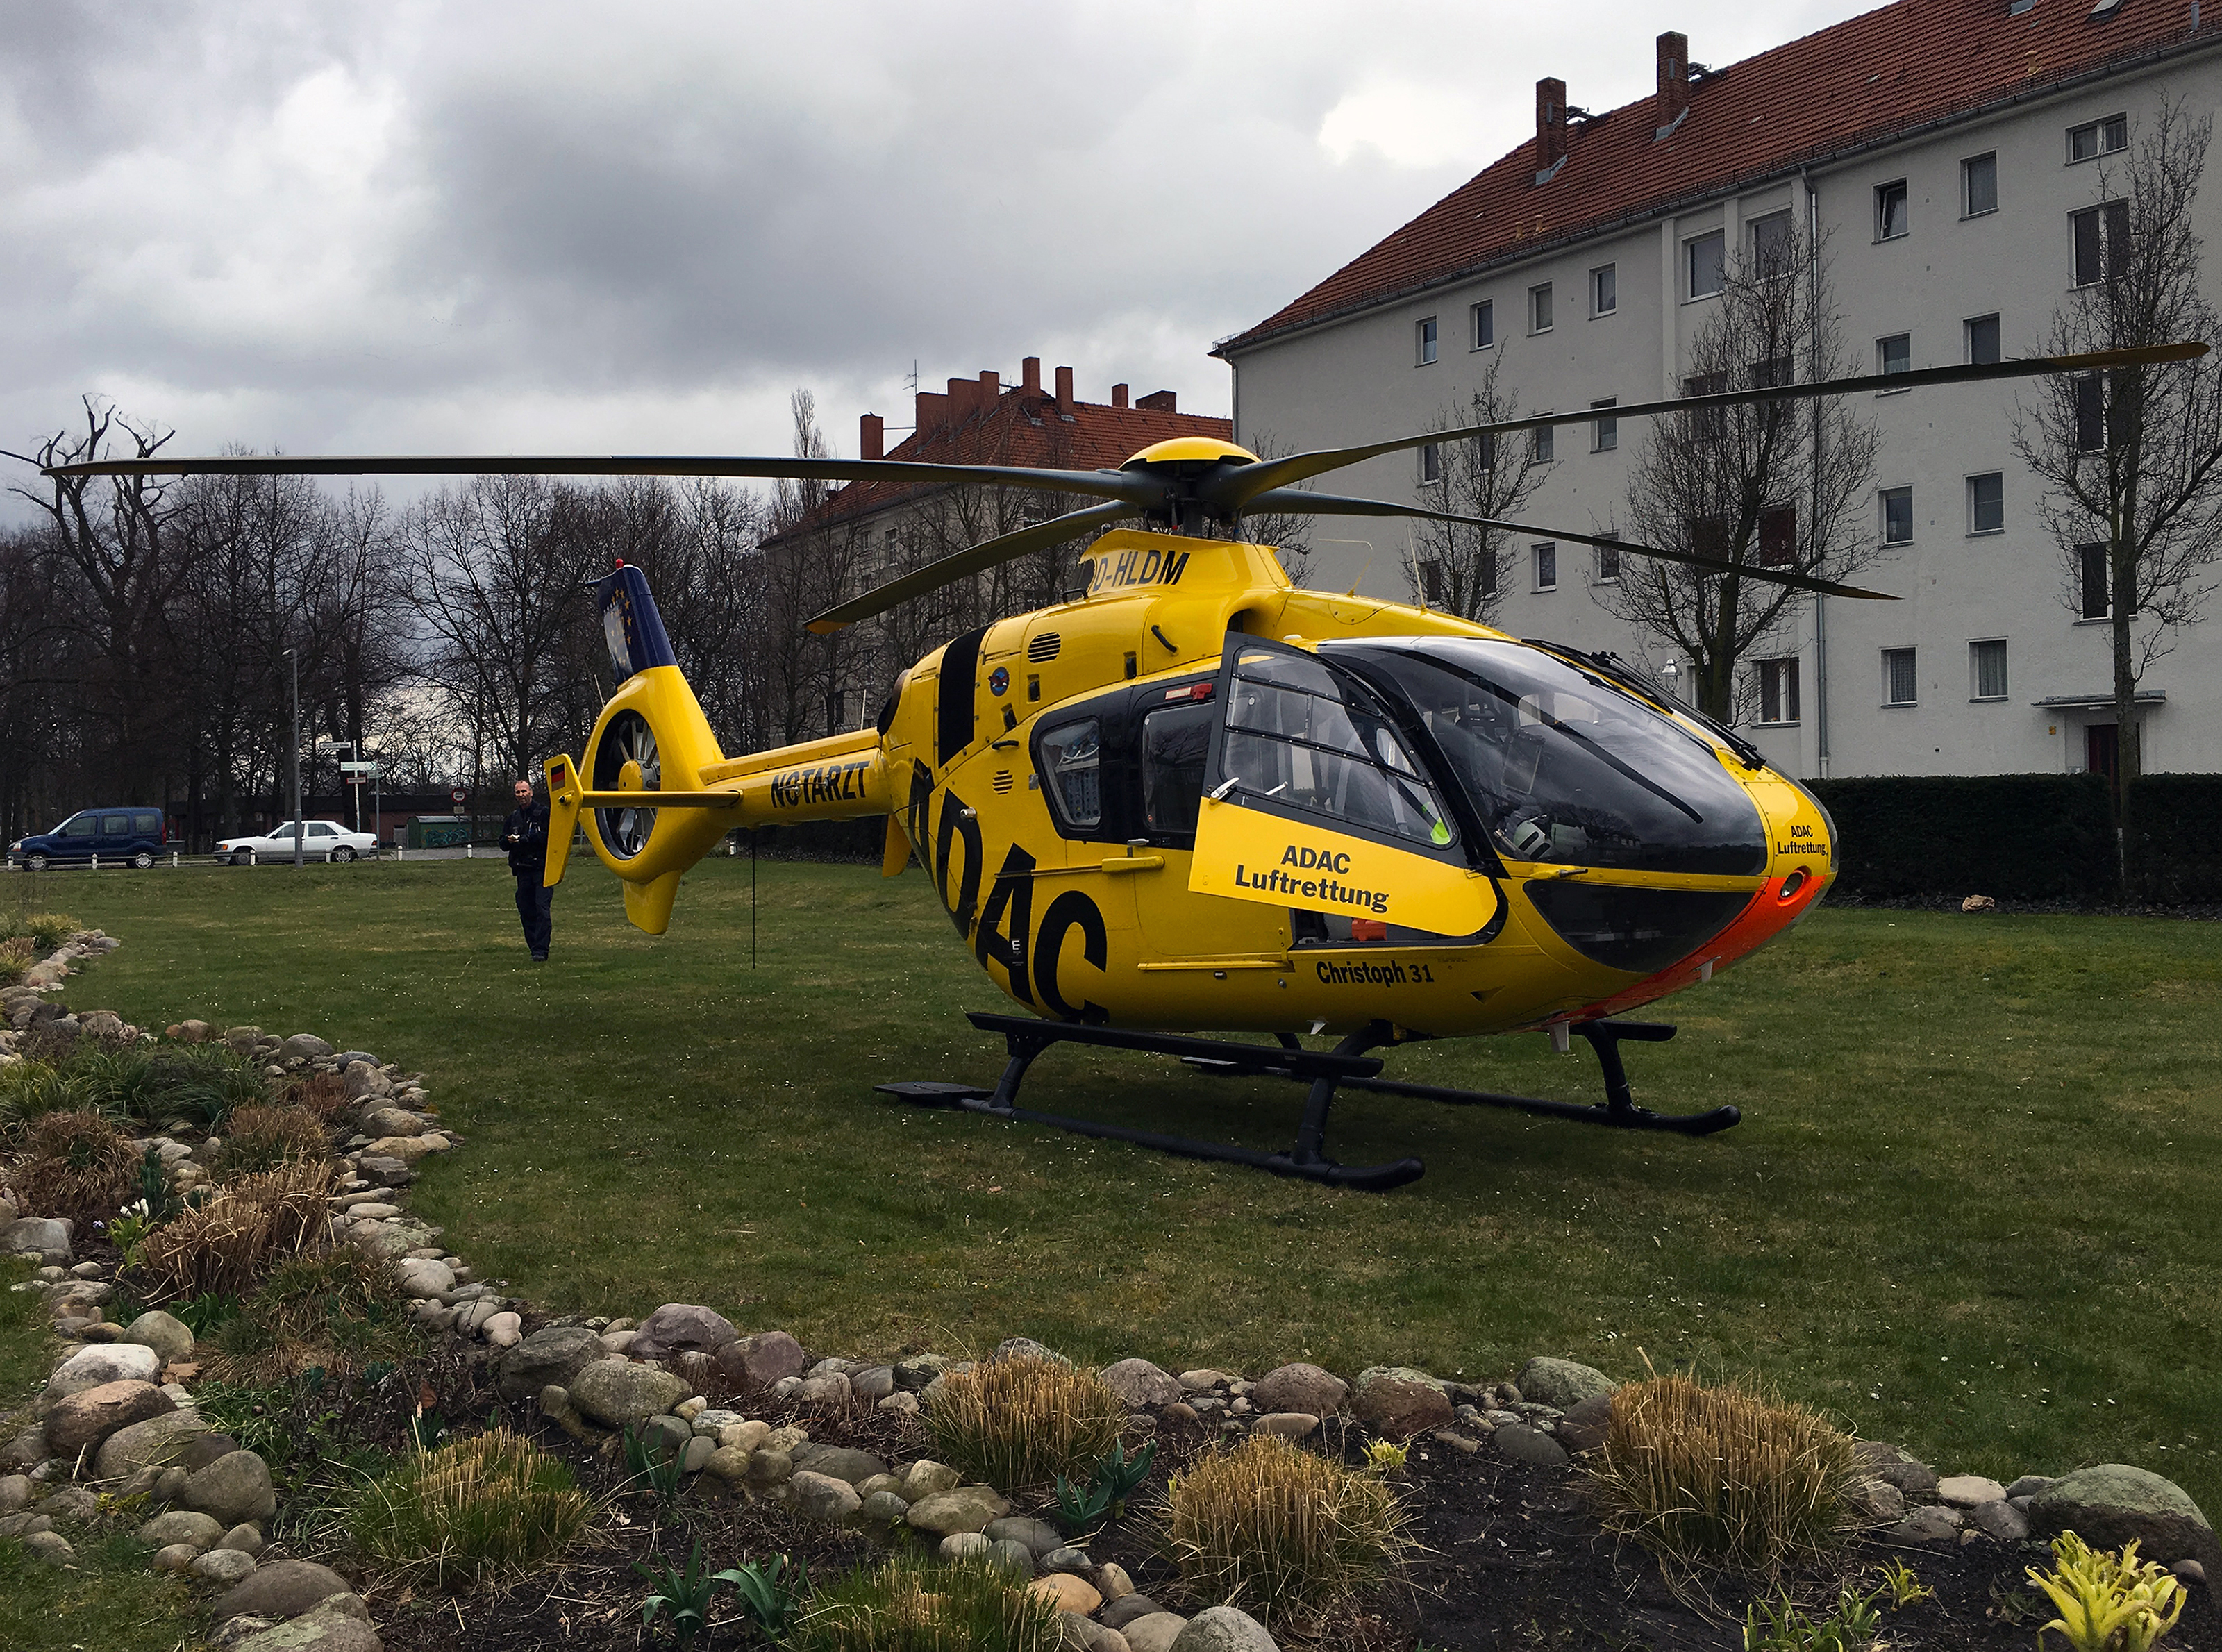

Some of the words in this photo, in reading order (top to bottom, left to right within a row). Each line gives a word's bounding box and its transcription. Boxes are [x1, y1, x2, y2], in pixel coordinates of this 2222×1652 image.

[1093, 550, 1190, 591] D-HLDM
[771, 761, 870, 808] NOTARZT
[1778, 841, 1826, 856] Luftrettung
[1791, 825, 1813, 837] ADAC
[1280, 845, 1351, 874] ADAC
[908, 757, 1110, 1024] ADAC
[1235, 865, 1389, 913] Luftrettung
[1316, 960, 1407, 988] Christoph
[1408, 964, 1435, 983] 31
